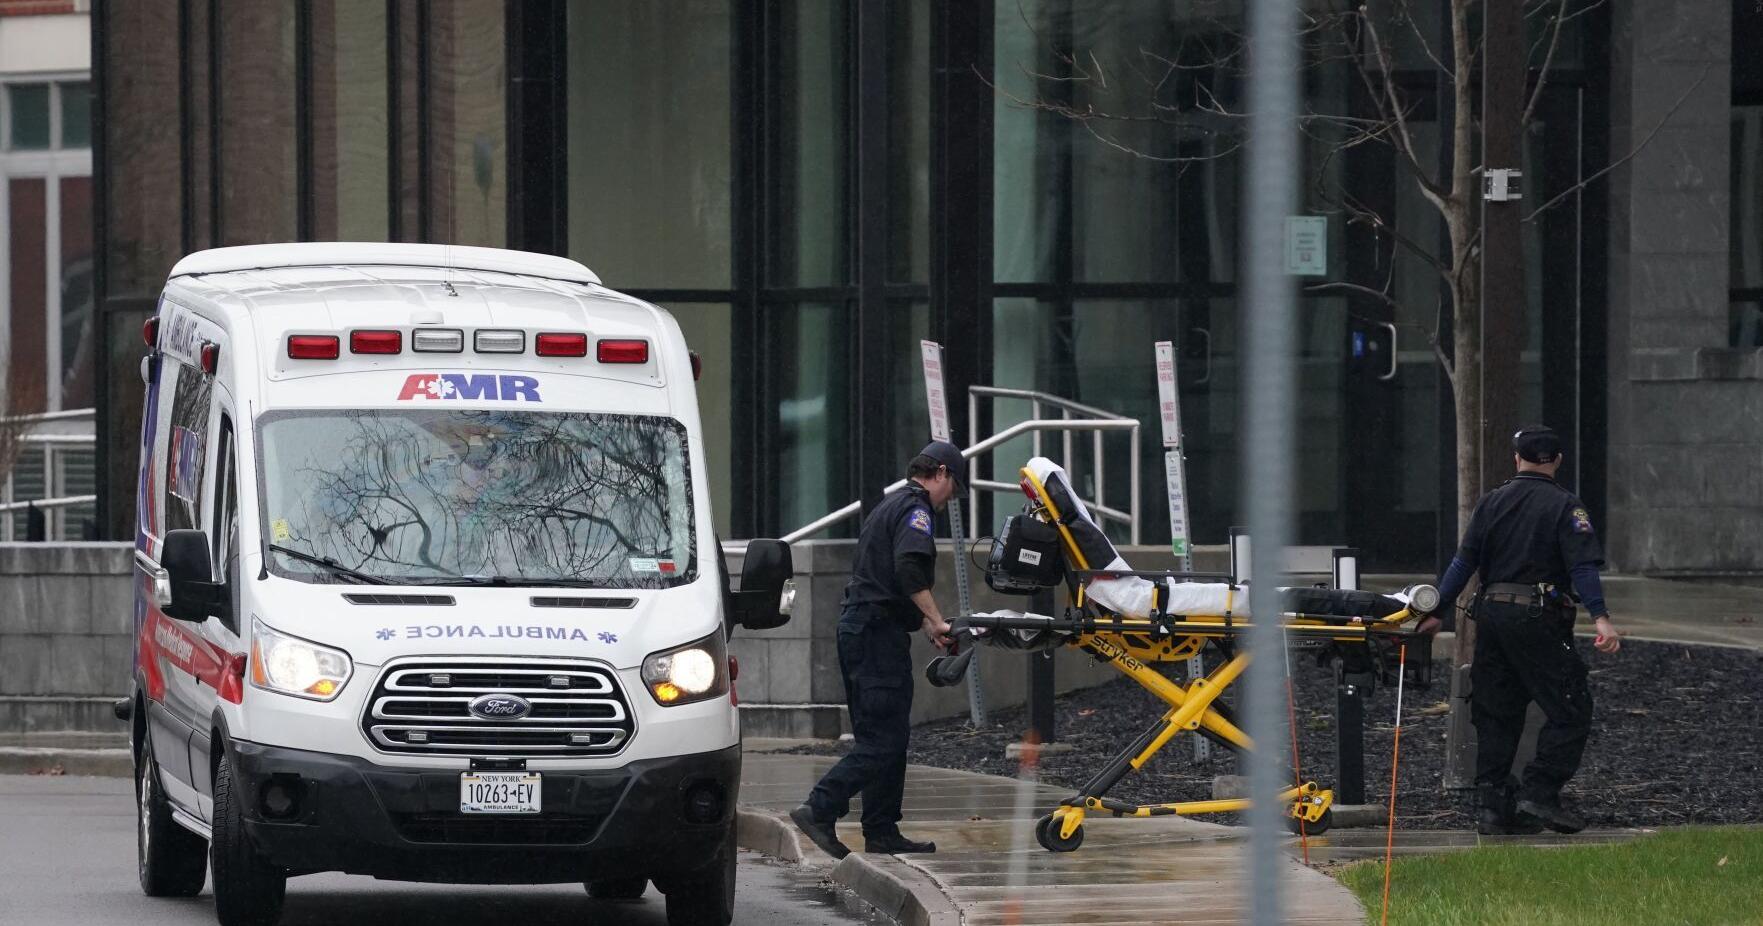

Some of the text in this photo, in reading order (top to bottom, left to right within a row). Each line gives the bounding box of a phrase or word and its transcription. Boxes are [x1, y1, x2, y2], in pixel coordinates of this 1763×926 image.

[397, 373, 543, 402] AMR
[1090, 635, 1144, 671] stryker
[484, 699, 517, 714] Ford
[468, 783, 509, 804] 10263
